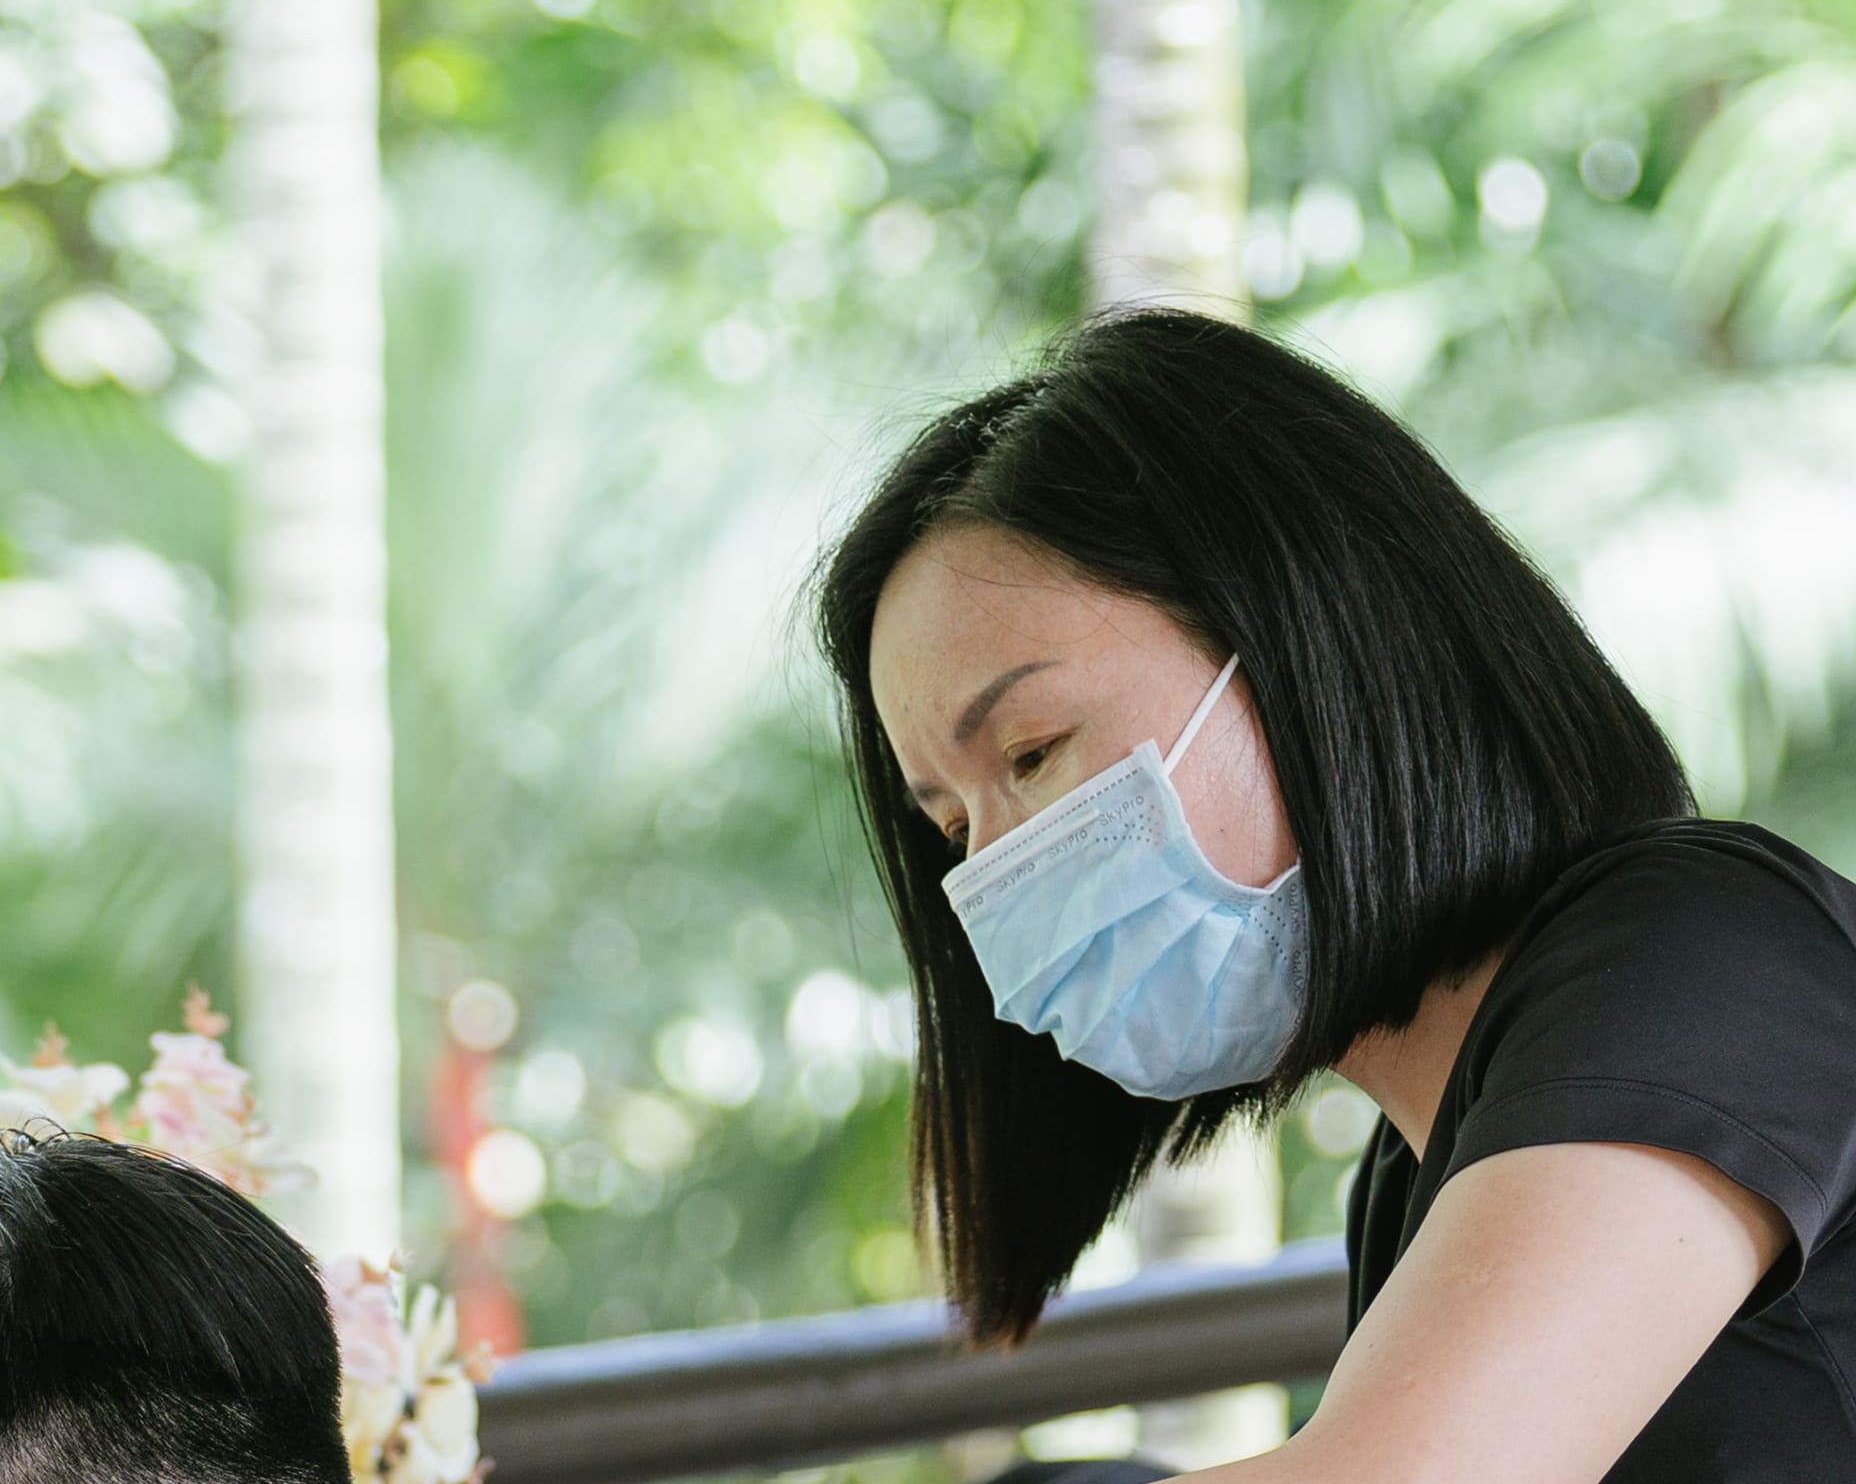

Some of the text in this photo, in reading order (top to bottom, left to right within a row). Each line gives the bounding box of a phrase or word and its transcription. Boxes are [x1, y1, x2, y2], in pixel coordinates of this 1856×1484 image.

[1097, 795, 1145, 828] SkyPro
[1048, 828, 1089, 860] SkyPro
[997, 861, 1036, 893] SkyPro
